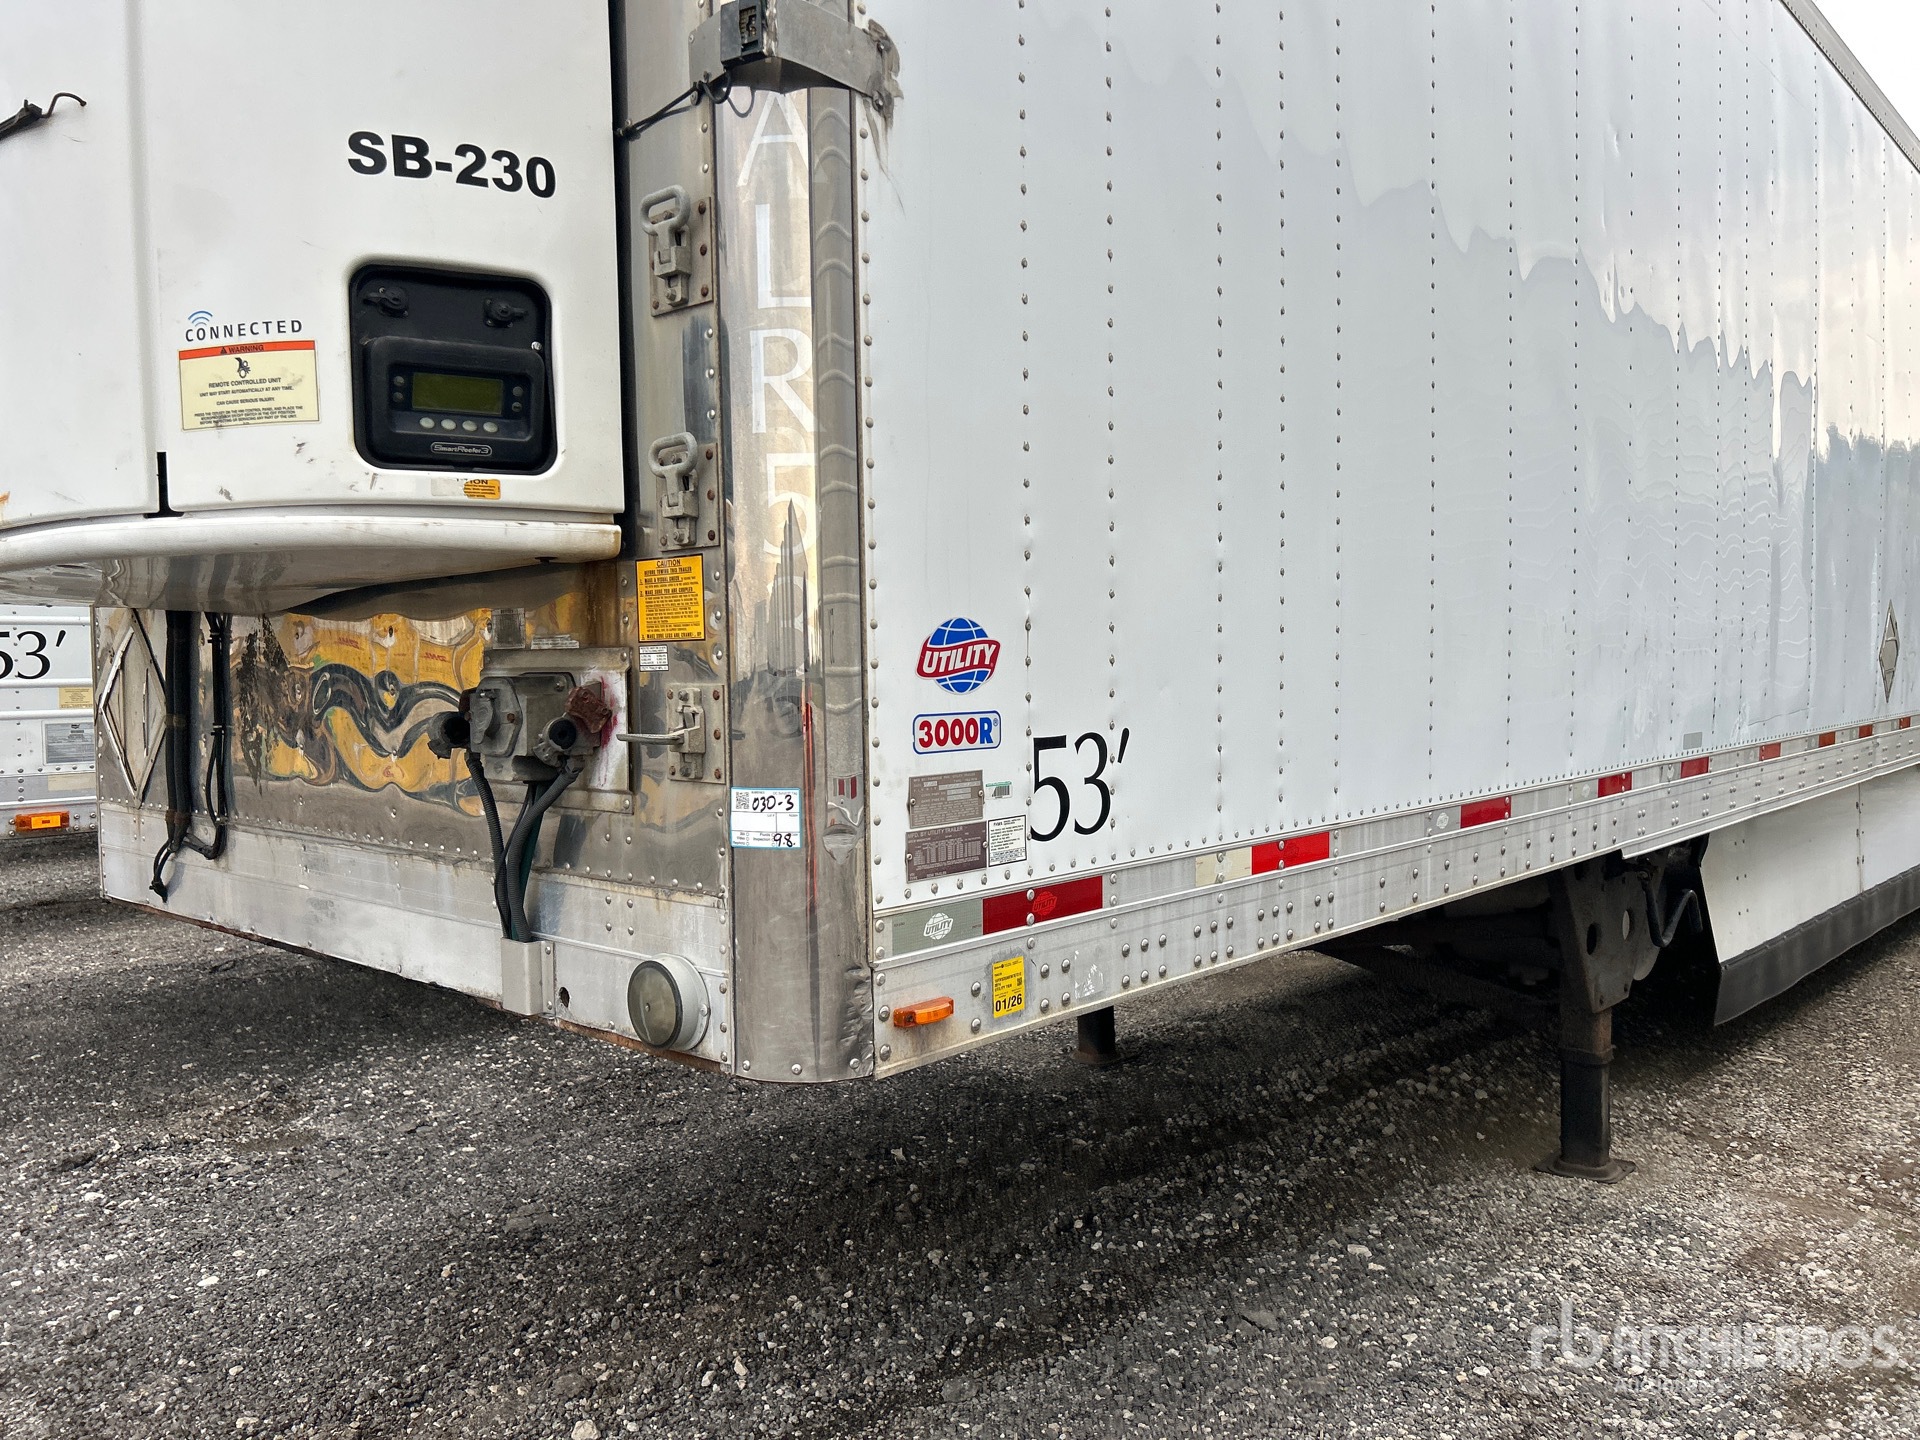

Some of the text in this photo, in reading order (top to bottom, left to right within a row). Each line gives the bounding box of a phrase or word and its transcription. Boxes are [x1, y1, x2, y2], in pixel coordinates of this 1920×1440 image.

[348, 131, 556, 198] SB-230
[185, 320, 303, 342] CONNECTED
[228, 344, 264, 353] WARNING
[230, 378, 267, 387] CONTROLLED
[232, 387, 264, 395] AUTOMATICALLY
[656, 559, 681, 568] CAUTION
[922, 644, 996, 674] UTILITY
[918, 717, 993, 748] 3000R
[1030, 728, 1130, 842] 53'
[752, 794, 794, 812] 030-3
[1034, 899, 1056, 912] UTILITY
[926, 920, 952, 934] UTILITY
[996, 994, 1022, 1012] 01/26
